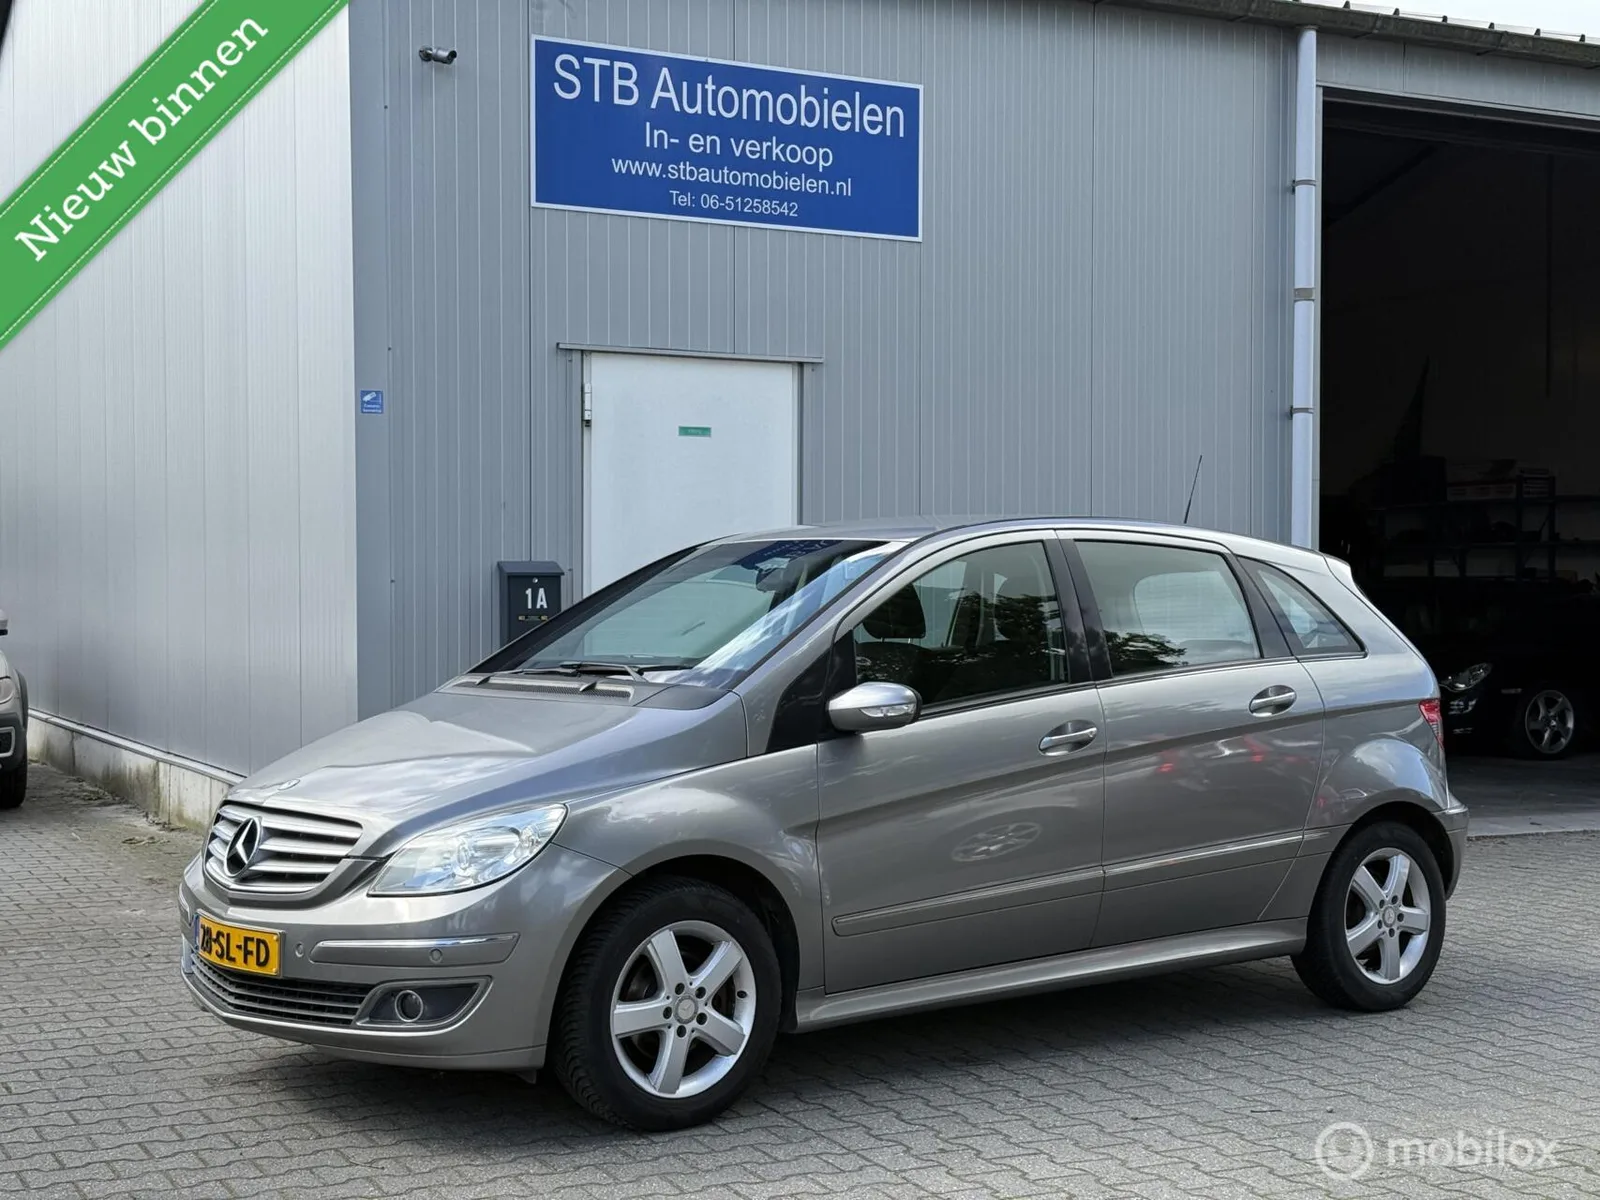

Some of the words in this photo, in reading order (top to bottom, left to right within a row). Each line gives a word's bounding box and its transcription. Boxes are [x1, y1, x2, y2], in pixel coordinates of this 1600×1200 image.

[554, 53, 640, 106] STB
[650, 66, 905, 138] Automobielen
[645, 121, 680, 150] In-
[688, 133, 721, 155] en
[730, 135, 833, 173] verkoop
[611, 157, 852, 197] www.stbautomobielen.nl
[669, 190, 696, 207] Tel:
[700, 193, 799, 217] 06-51258542
[525, 587, 548, 609] 1A
